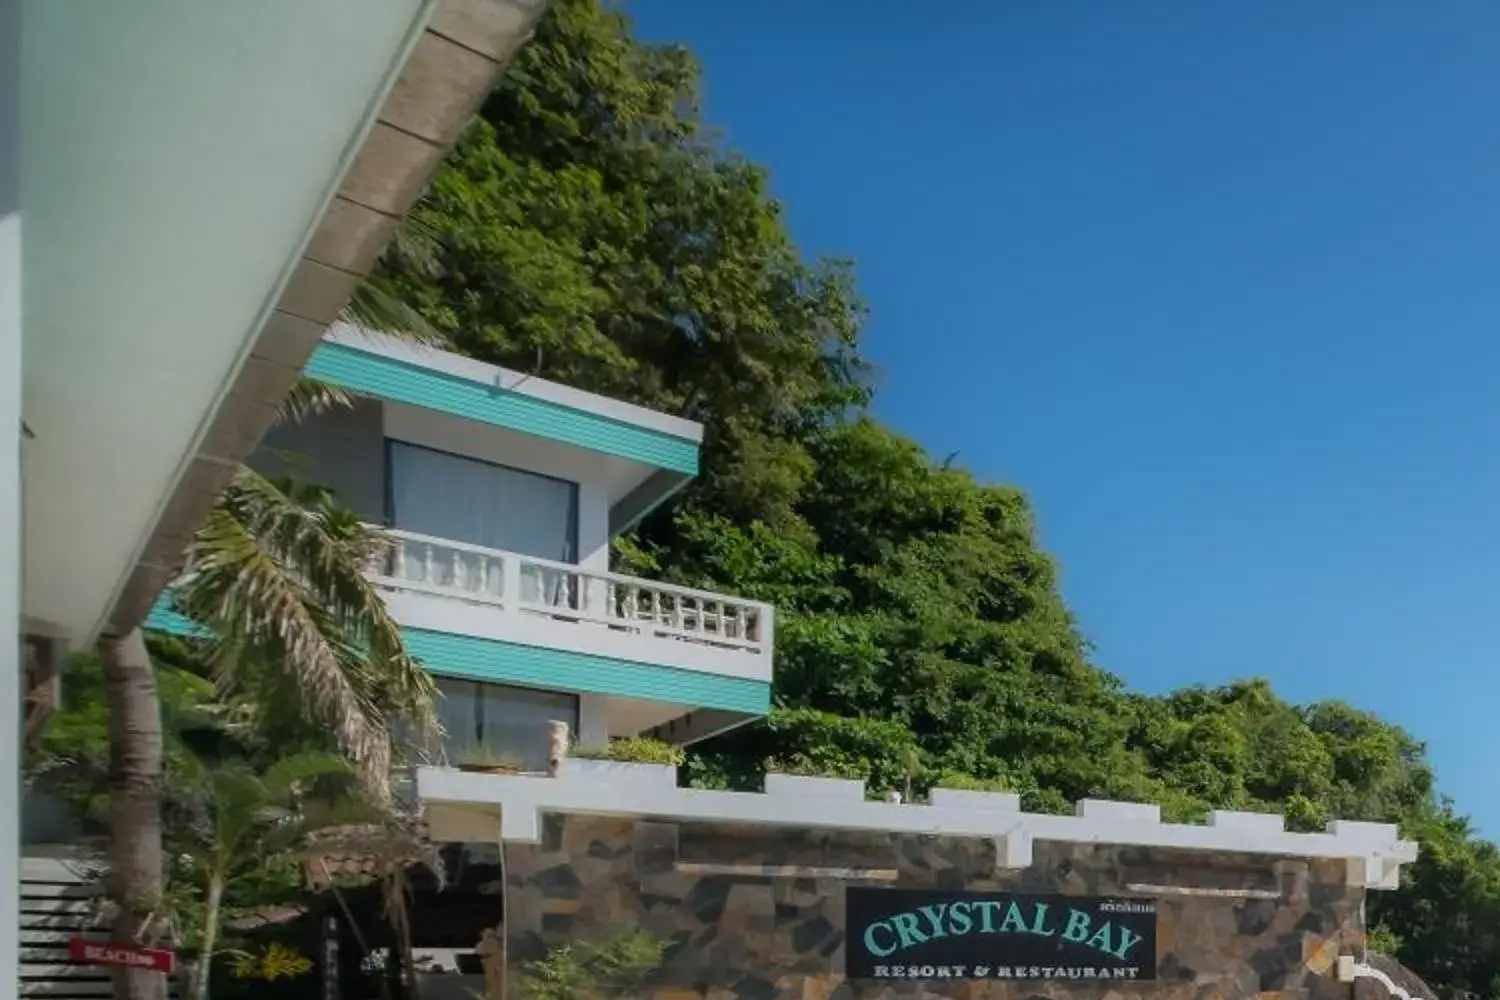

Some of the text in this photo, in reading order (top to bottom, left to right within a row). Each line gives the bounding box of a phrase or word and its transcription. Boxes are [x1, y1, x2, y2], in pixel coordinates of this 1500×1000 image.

[864, 901, 1143, 961] CRYSTAL BAY
[873, 965, 1140, 979] RESORT & RESTAURANT
